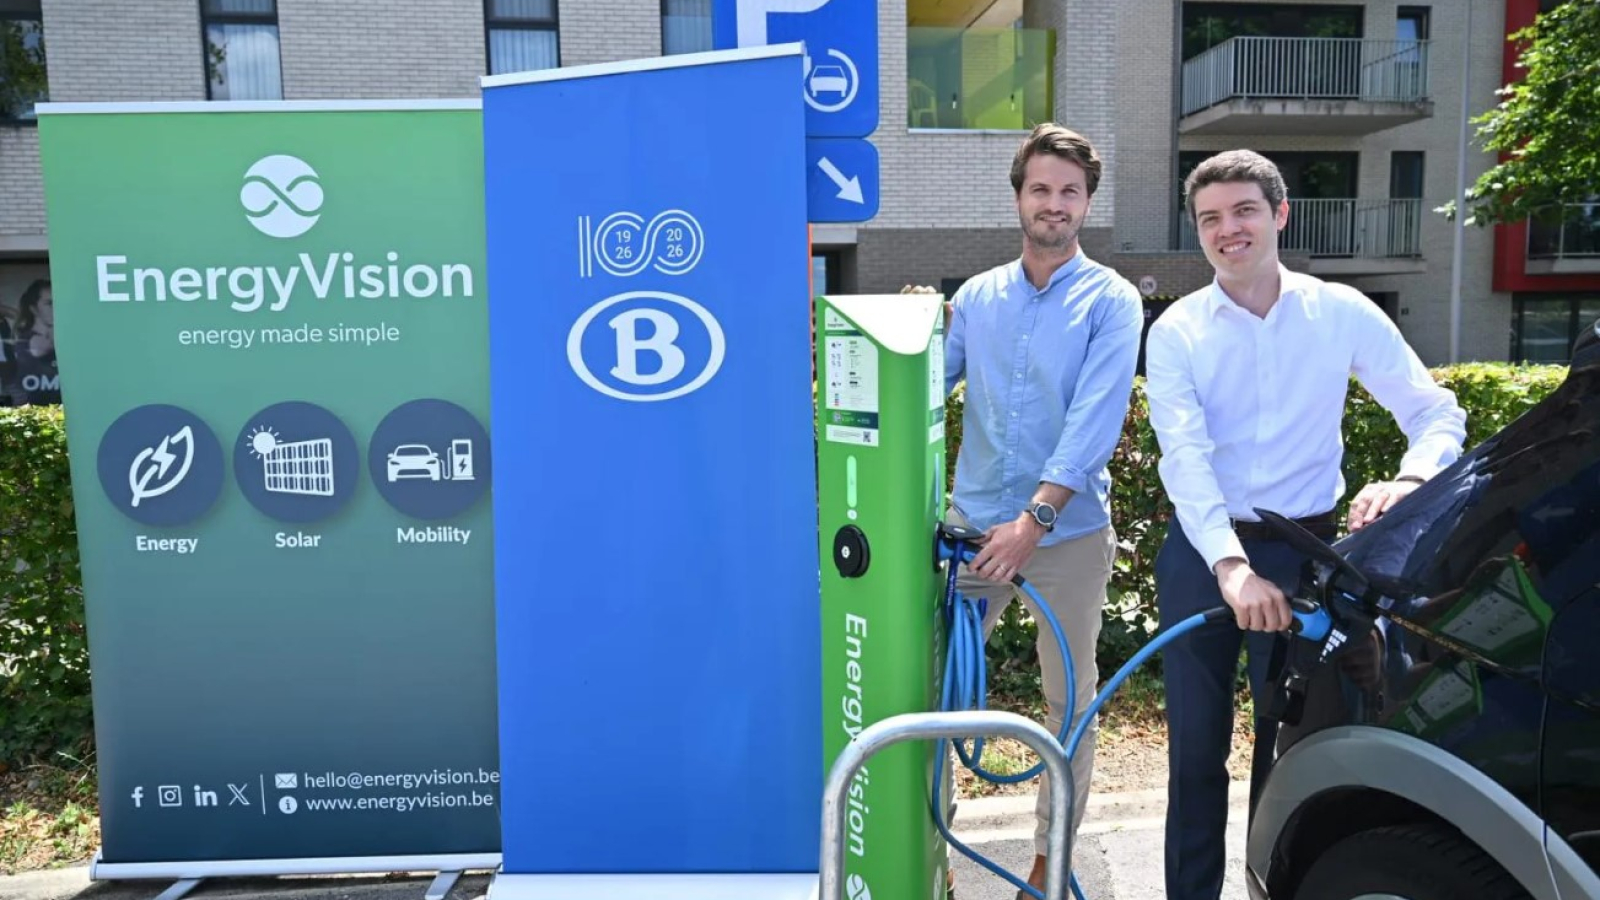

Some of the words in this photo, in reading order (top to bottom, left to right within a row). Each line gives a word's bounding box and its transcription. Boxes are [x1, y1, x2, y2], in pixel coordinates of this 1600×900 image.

[615, 230, 631, 243] 19
[666, 227, 683, 242] 20
[615, 247, 632, 259] 26
[667, 244, 684, 258] 26
[96, 252, 474, 313] EnergyVision
[178, 329, 255, 349] energy
[261, 324, 323, 343] made
[328, 321, 400, 346] simple
[608, 308, 685, 385] B
[136, 535, 198, 554] Energy
[275, 531, 321, 548] Solar
[397, 526, 471, 545] Mobility
[842, 613, 868, 857] Energyision
[304, 768, 500, 788] hello@energyvision.be
[306, 791, 494, 812] www.energyvision.be
